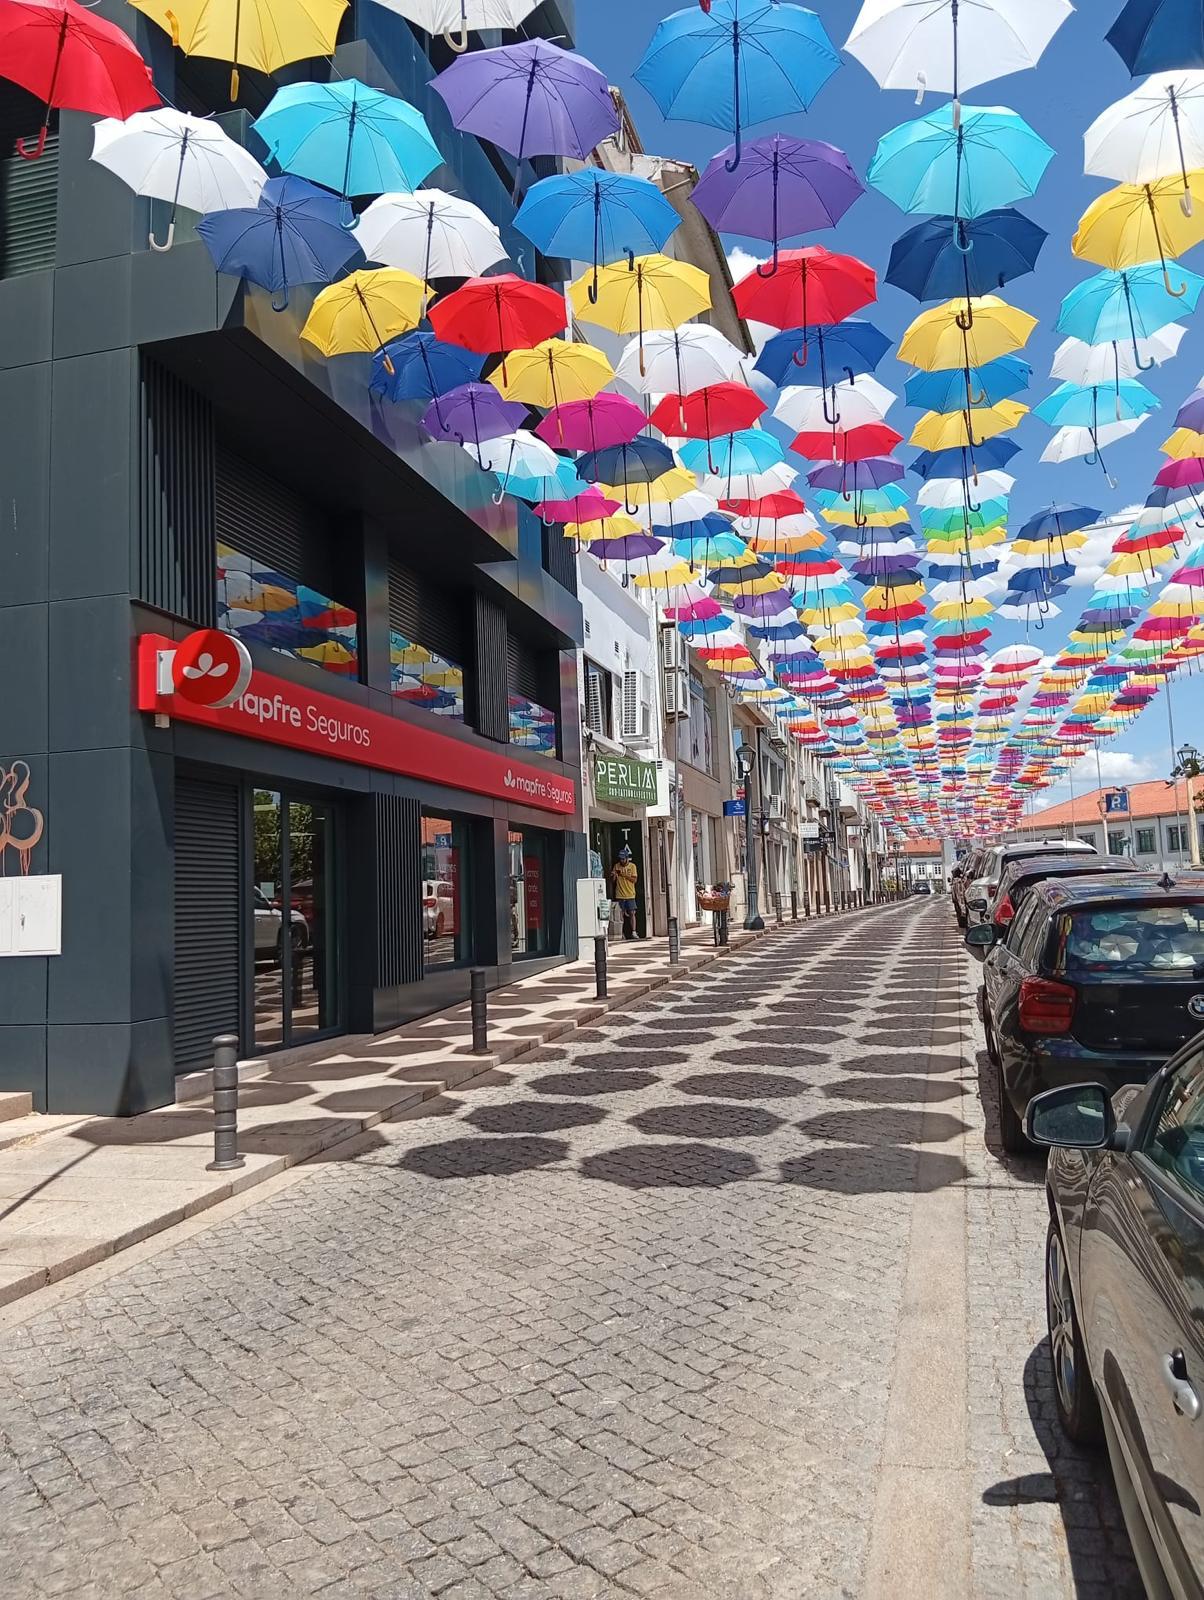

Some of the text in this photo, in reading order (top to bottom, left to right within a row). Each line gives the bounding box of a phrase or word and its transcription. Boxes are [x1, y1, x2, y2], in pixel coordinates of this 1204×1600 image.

[306, 705, 371, 747] Seguros
[516, 776, 573, 804] mapfre Seguros
